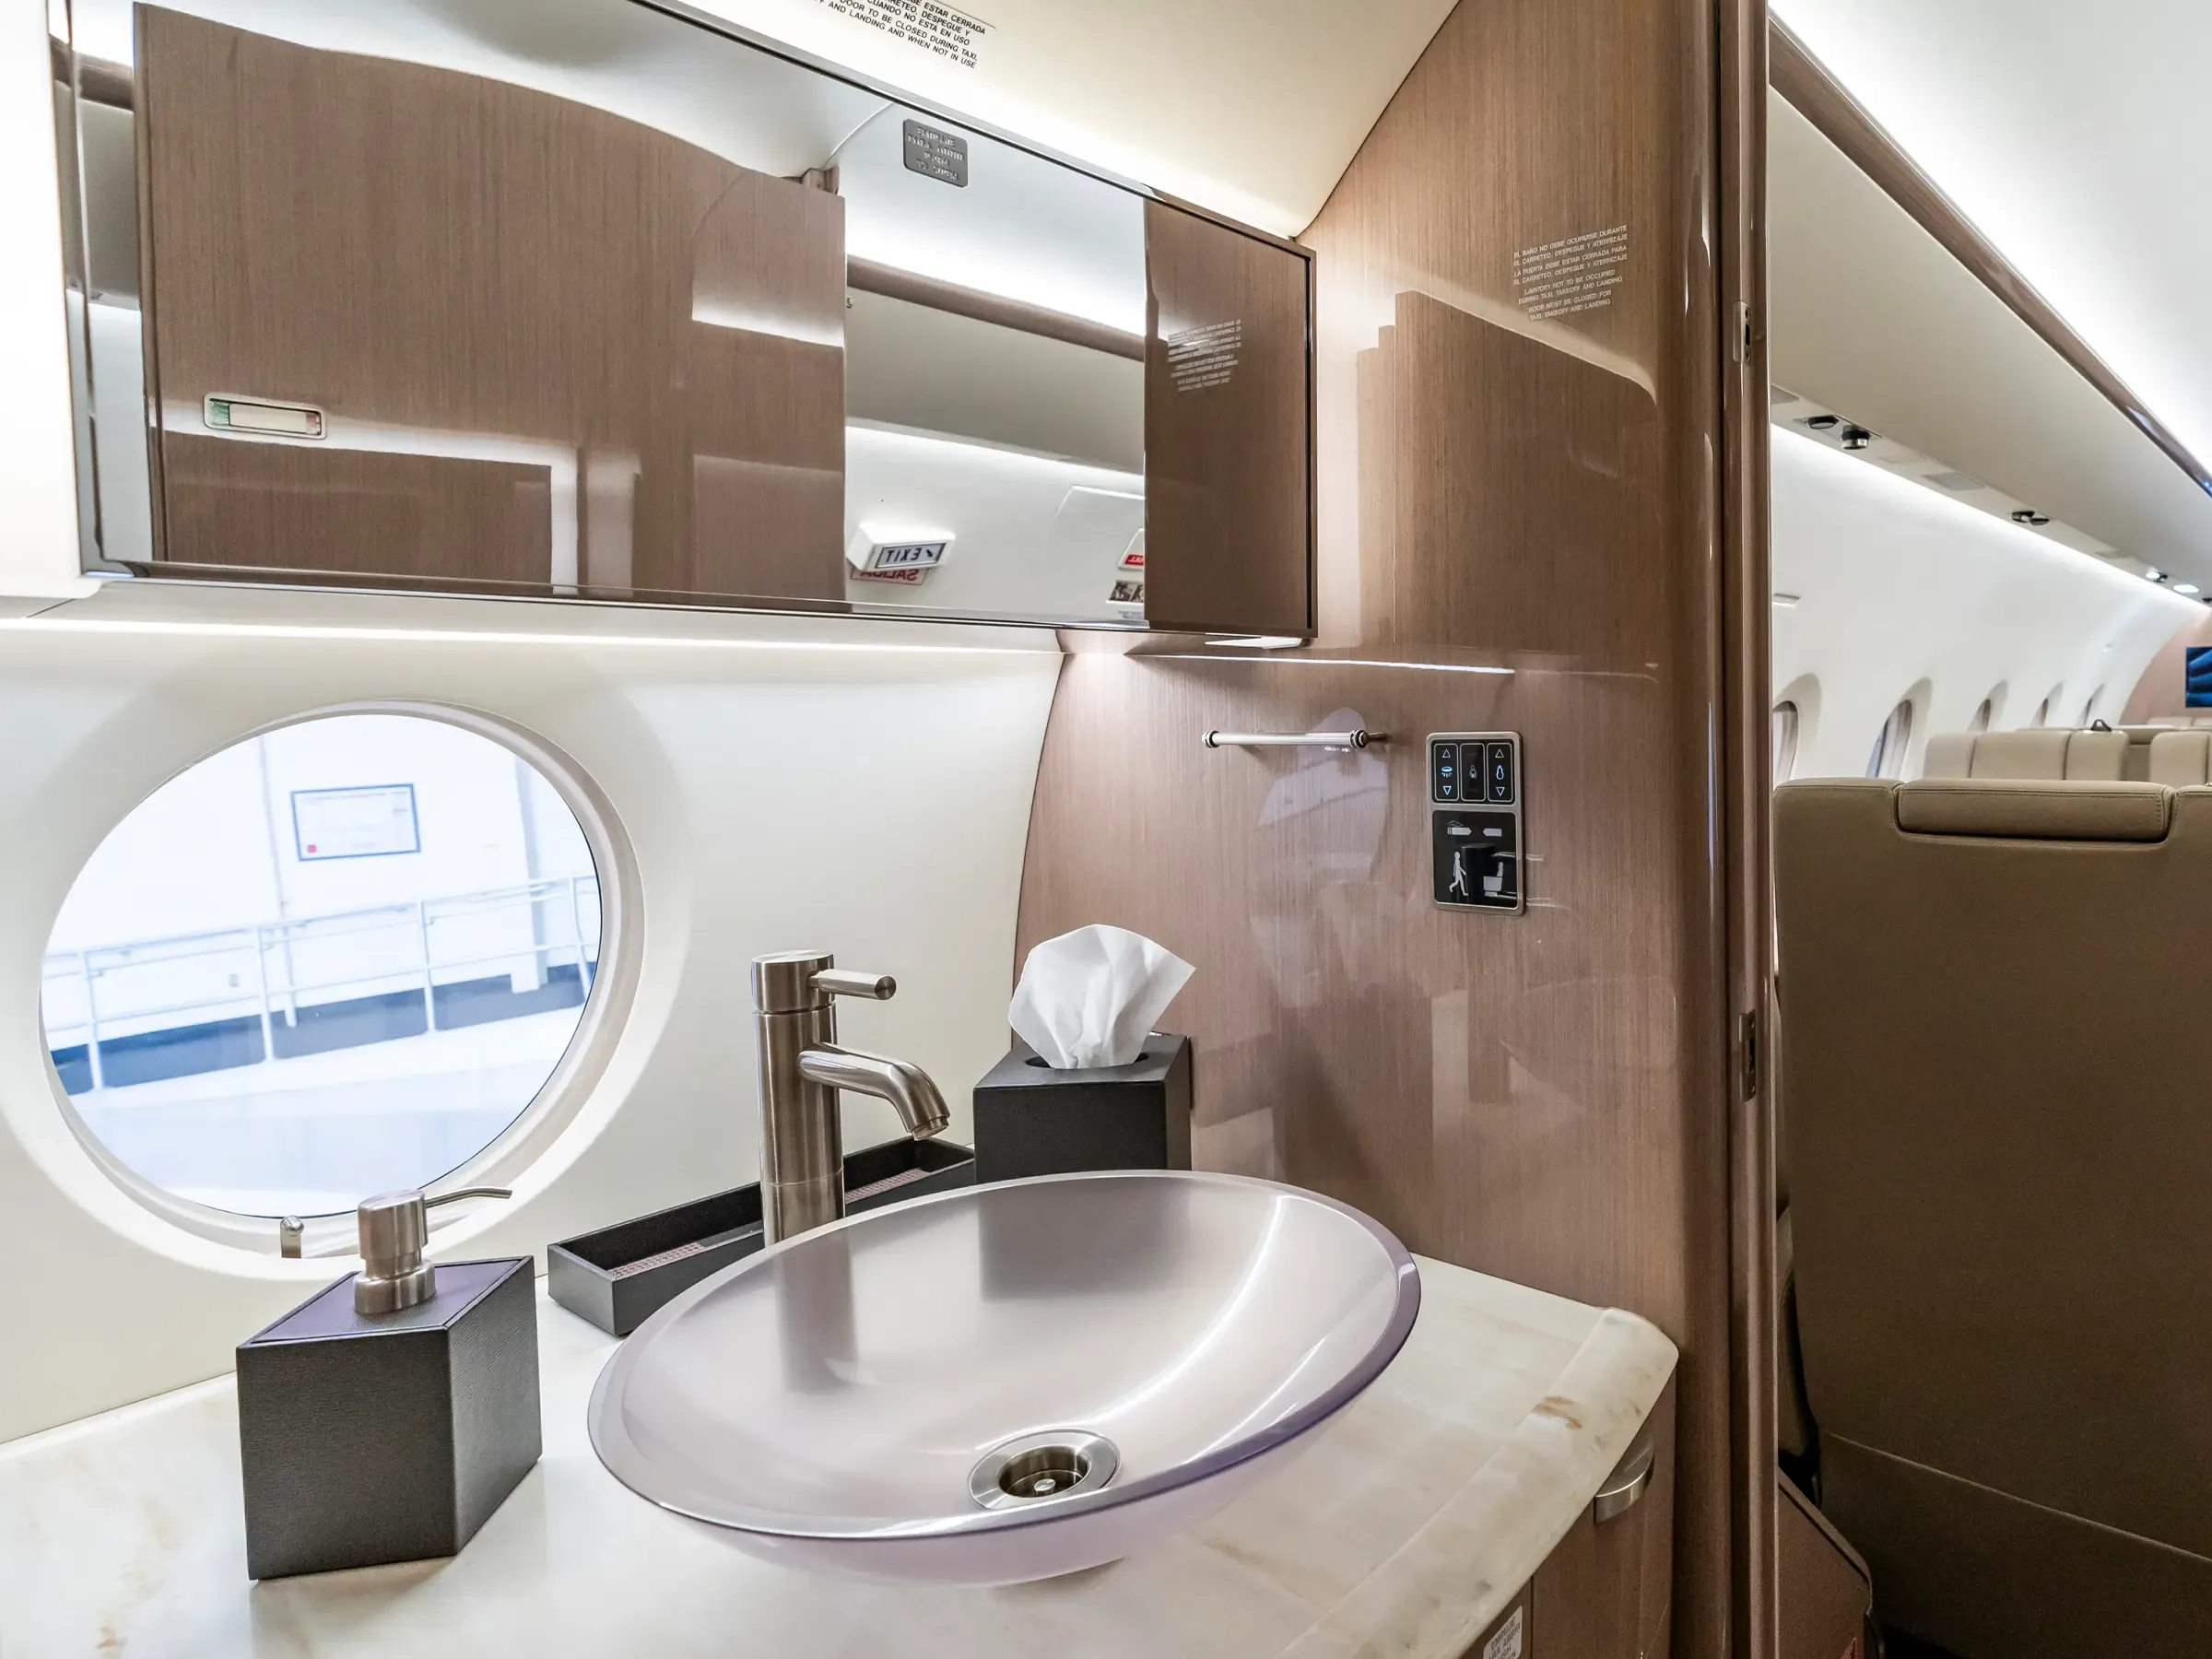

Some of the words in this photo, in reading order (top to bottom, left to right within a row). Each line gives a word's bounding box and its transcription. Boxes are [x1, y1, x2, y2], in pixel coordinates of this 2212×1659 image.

[868, 7, 878, 17] TO
[881, 15, 892, 24] BE
[895, 20, 927, 38] CLOSED
[930, 36, 959, 52] DURING
[888, 0, 917, 15] RETEO,
[922, 11, 962, 33] DESPEGUE
[904, 13, 915, 22] NO
[940, 29, 951, 37] EN
[953, 35, 970, 45] USO
[924, 2, 948, 18] ESTAR
[951, 15, 985, 34] CERRADA
[829, 2, 846, 13] AND
[849, 10, 885, 29] LANDING
[888, 27, 904, 37] AND
[908, 34, 930, 49] WHEN
[933, 46, 948, 56] NOT
[960, 58, 976, 68] USE
[1567, 232, 1597, 244] OCUPARSE
[1600, 225, 1628, 237] DURANTE
[1524, 265, 1543, 275] PUERTA
[1562, 256, 1580, 265] ESTAR
[1583, 250, 1609, 260] CERRADA
[1612, 245, 1627, 253] PARA
[1555, 243, 1584, 256] DESPEGUE
[1555, 264, 1584, 276] DESPEGUE
[1585, 270, 1615, 280] OCCUPIED
[1519, 296, 1539, 305] DURING
[1556, 286, 1581, 296] TAKEOFF
[1597, 276, 1622, 287] LANDING
[1528, 304, 1544, 312] DOOR
[1546, 300, 1561, 309] MUST
[1574, 293, 1596, 303] CLOSED
[1545, 307, 1569, 317] TAKEOFF
[1585, 299, 1610, 310] LANDING
